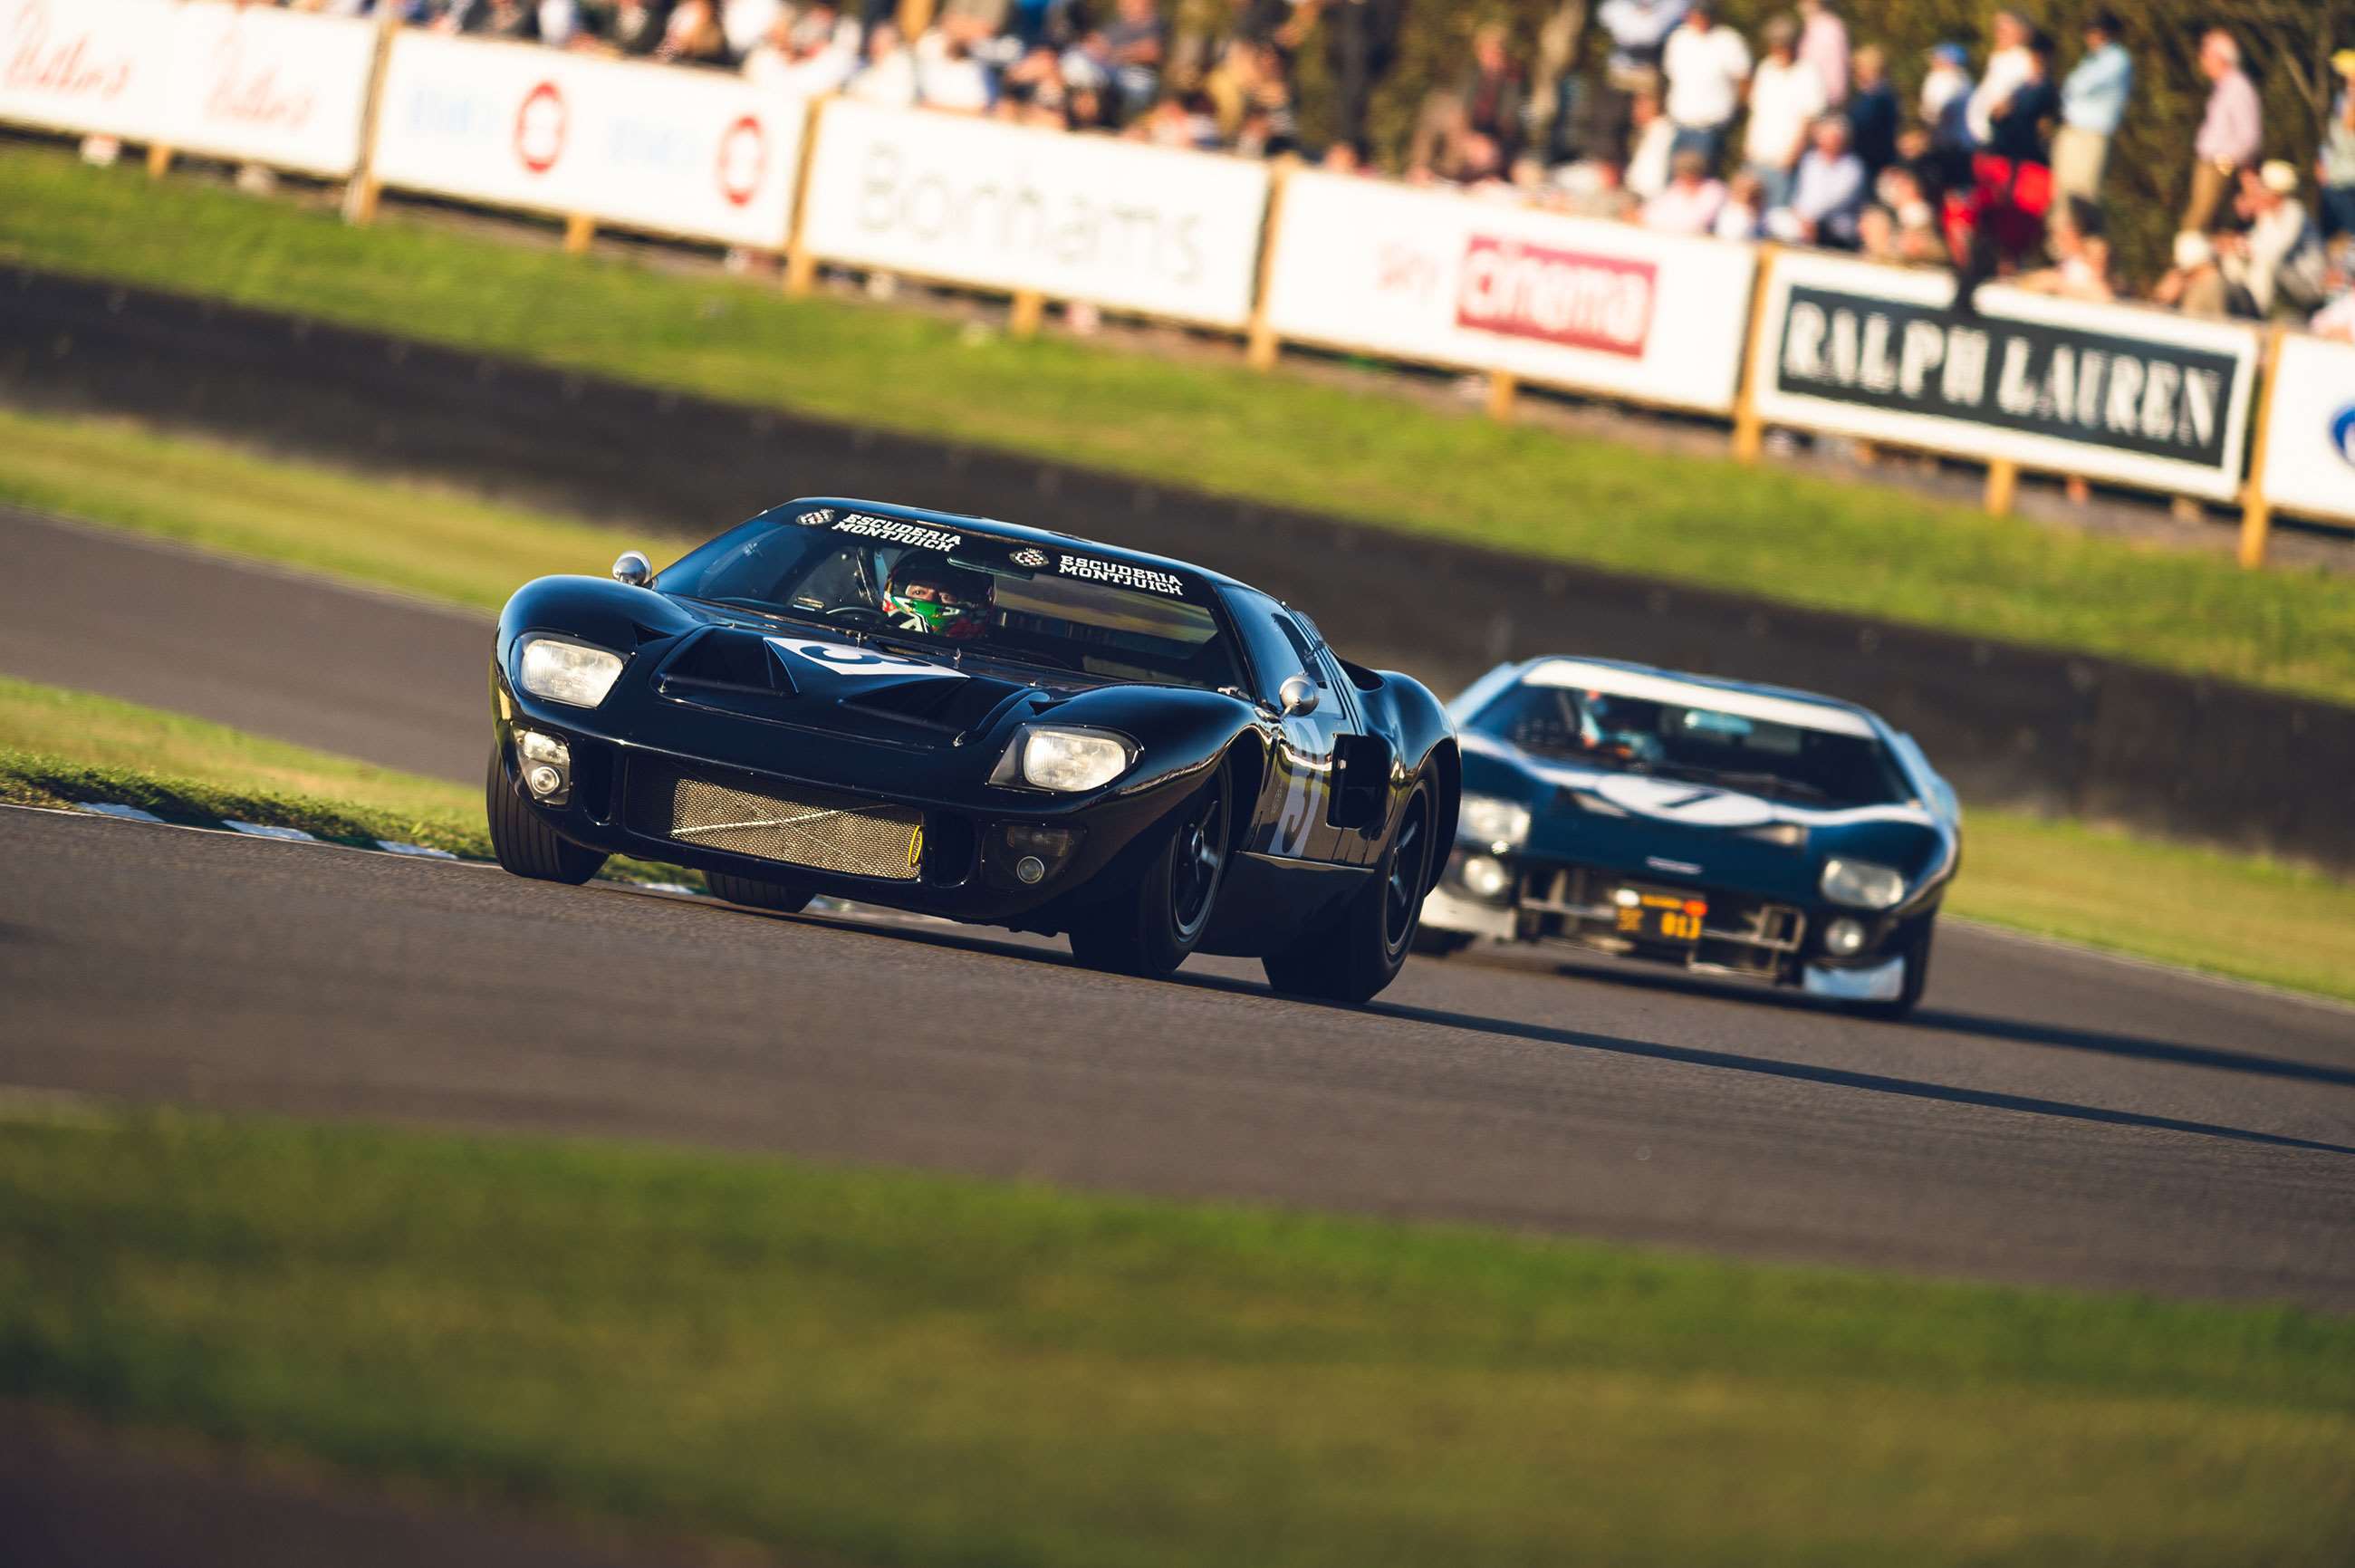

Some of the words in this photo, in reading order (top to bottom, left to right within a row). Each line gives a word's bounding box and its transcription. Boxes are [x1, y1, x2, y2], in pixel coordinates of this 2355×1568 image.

[855, 139, 1206, 286] Bonhams
[1456, 237, 1652, 347] cinema
[1782, 299, 1990, 408] RALPH
[1996, 334, 2222, 449] LAUREN
[831, 521, 955, 553] MONTJUICH
[843, 513, 961, 545] ESCUDERIA
[1059, 563, 1184, 596] MONTJUICH
[1060, 554, 1184, 586] ESCUDERIA
